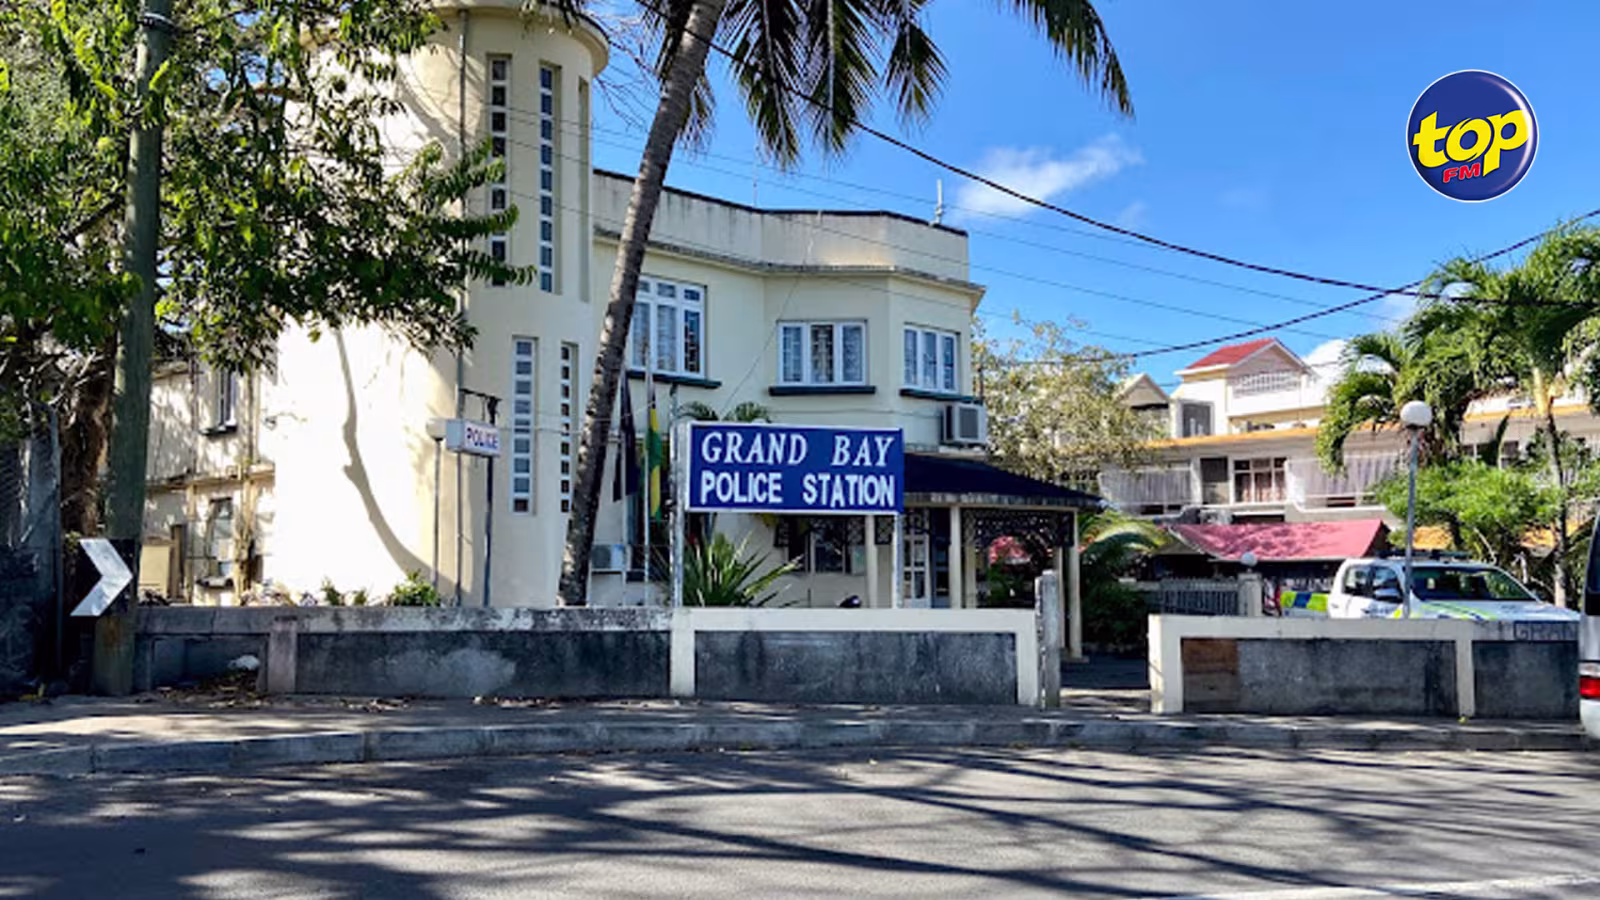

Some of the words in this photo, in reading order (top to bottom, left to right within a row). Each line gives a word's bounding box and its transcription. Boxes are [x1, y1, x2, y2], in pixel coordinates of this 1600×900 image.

[466, 427, 499, 449] POLICE
[702, 432, 808, 465] GRAND
[831, 435, 895, 467] BAY
[701, 470, 782, 505] POLICE
[803, 473, 895, 507] STATION
